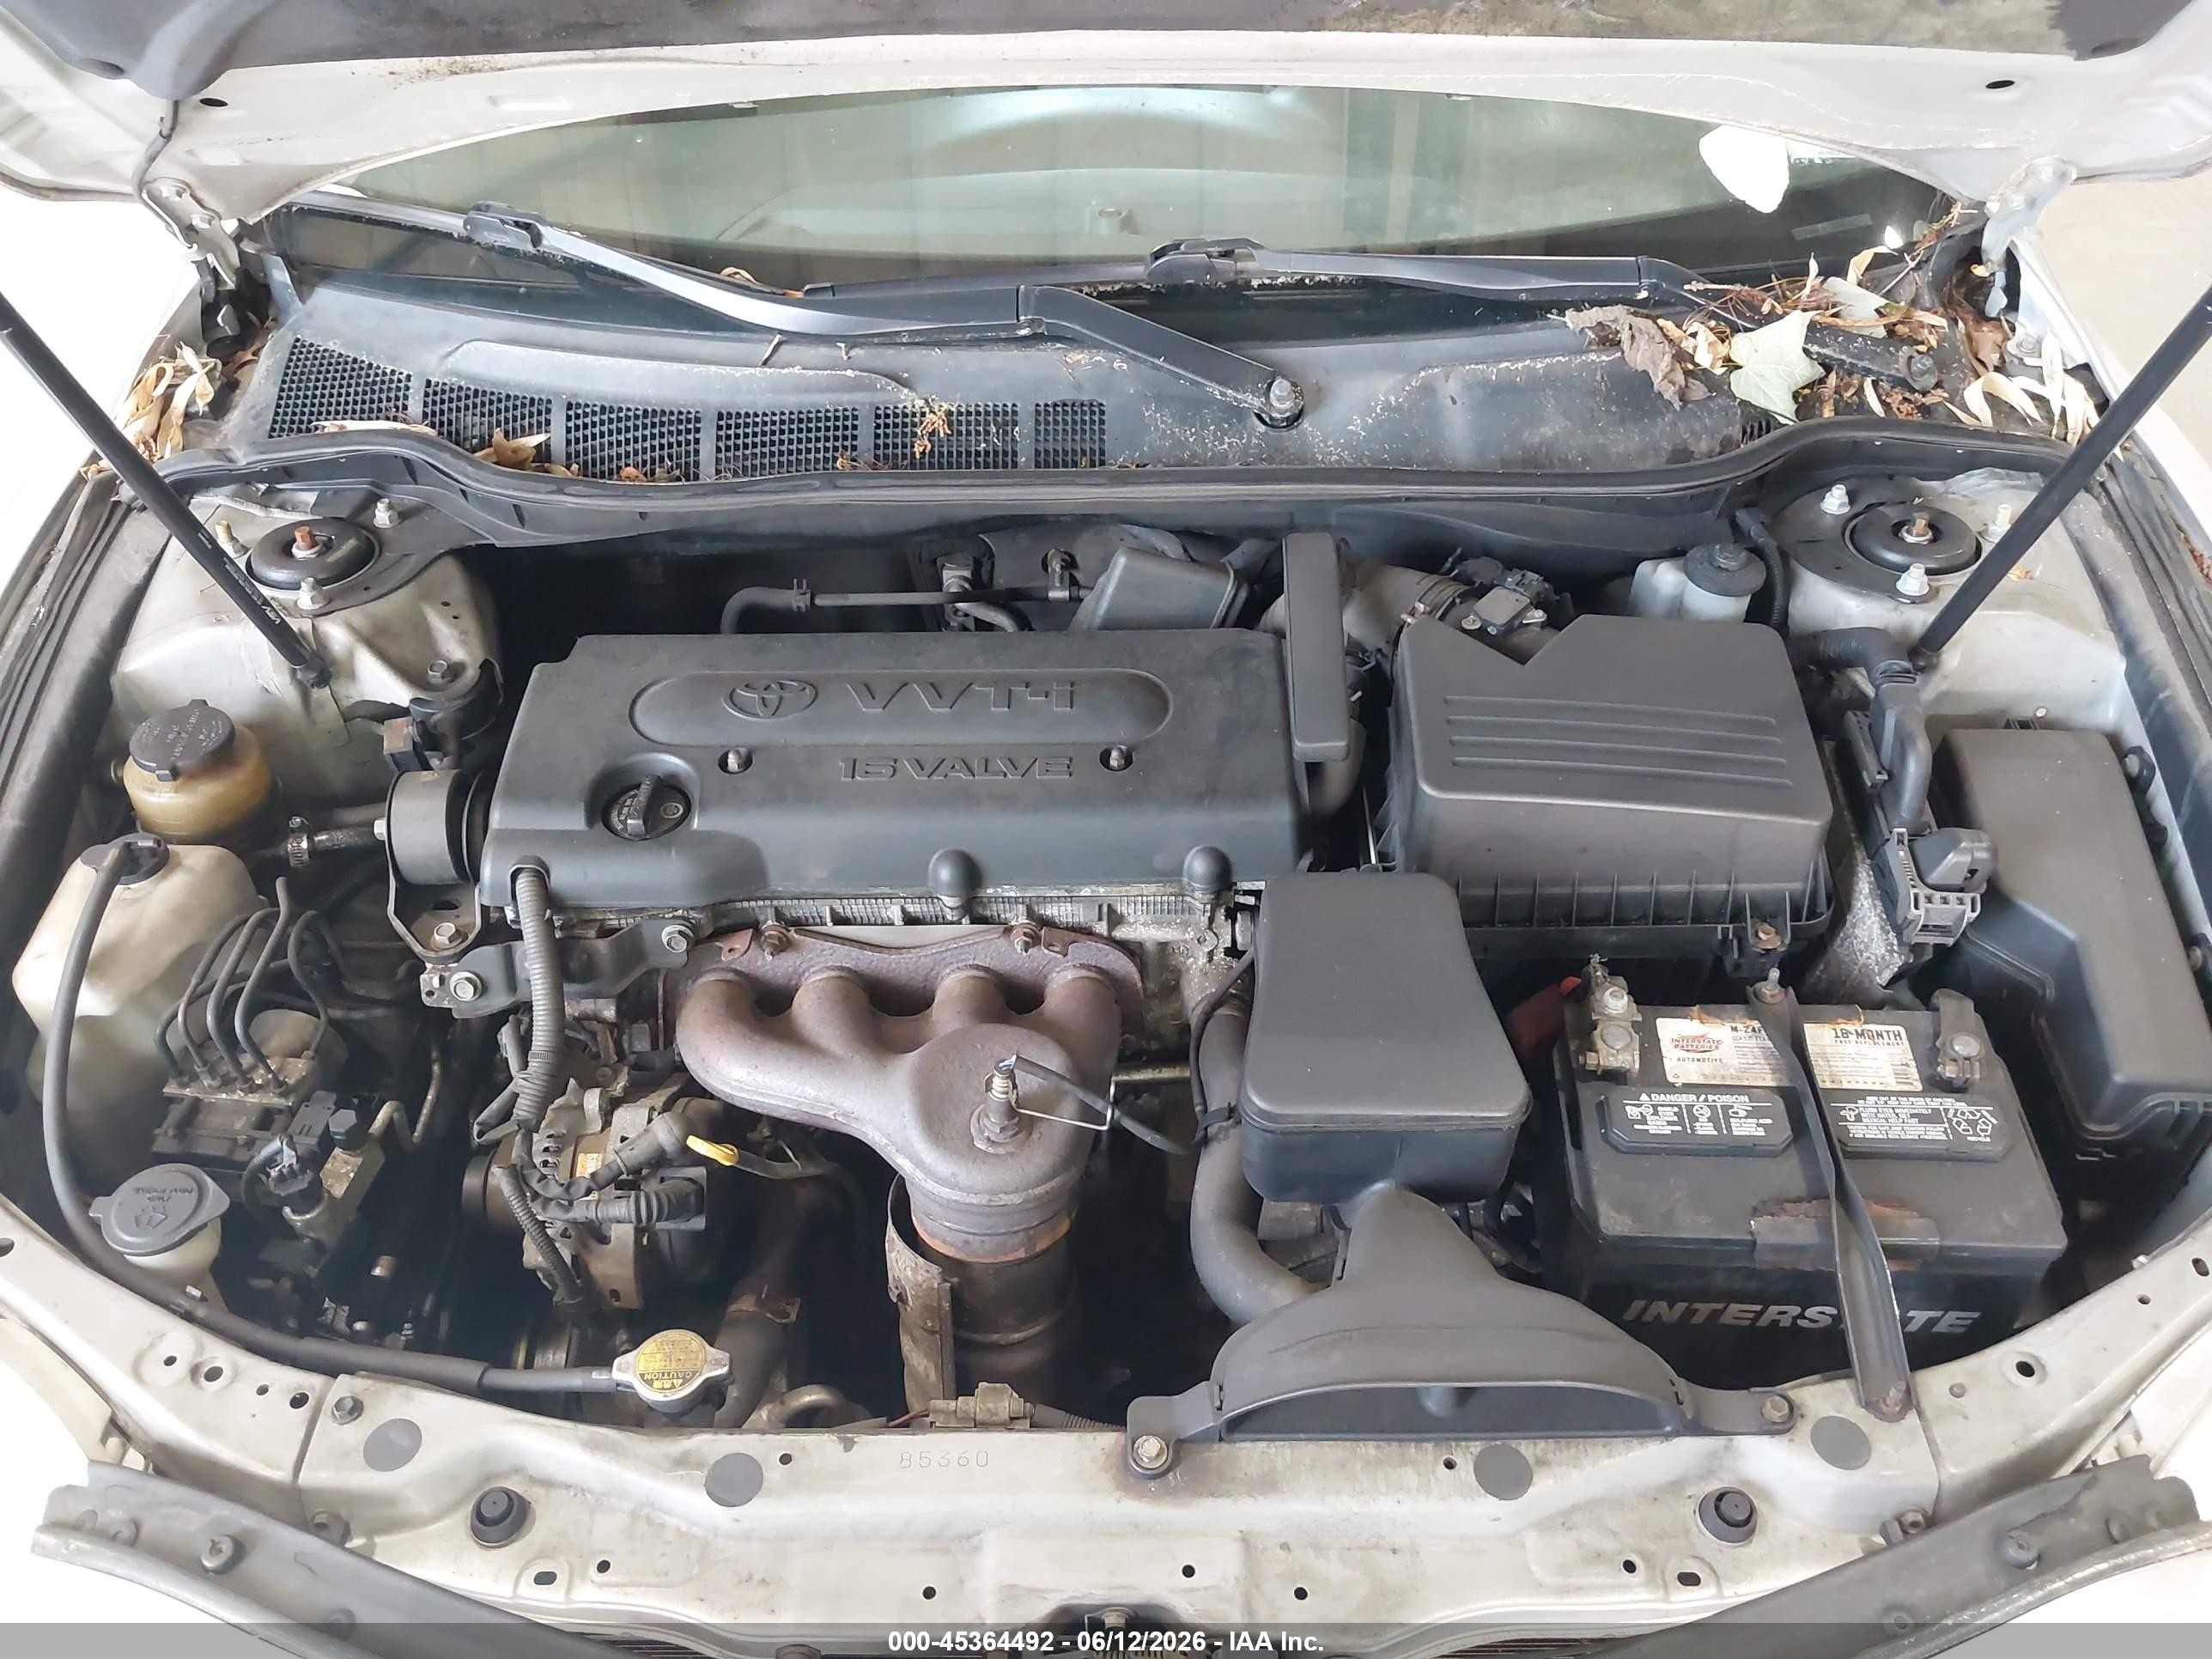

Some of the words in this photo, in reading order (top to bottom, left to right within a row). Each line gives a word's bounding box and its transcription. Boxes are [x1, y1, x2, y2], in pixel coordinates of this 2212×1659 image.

[846, 682, 1076, 712] VVT-i
[902, 757, 1073, 781] VALVE
[1651, 1093, 1698, 1103] DANGER
[1707, 1094, 1750, 1103] POISON
[643, 1371, 693, 1381] CAUTION
[899, 1449, 989, 1469] 85360
